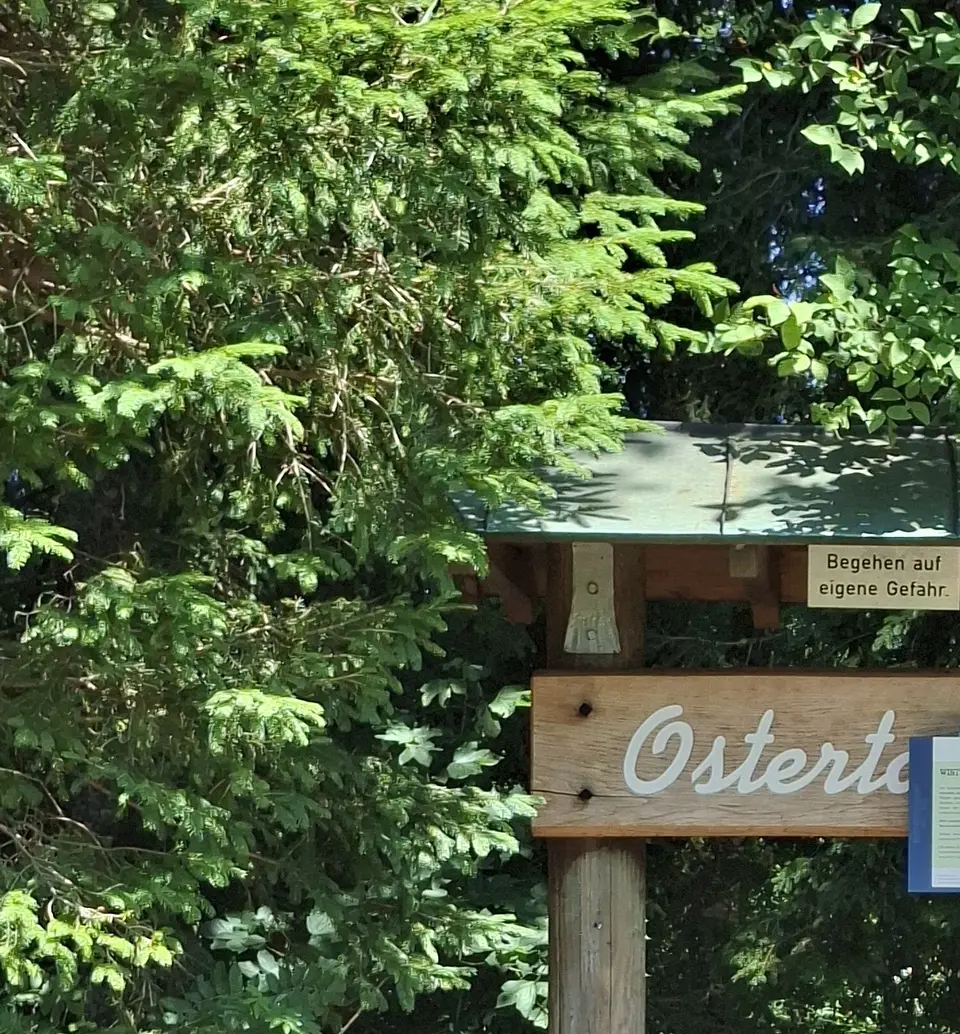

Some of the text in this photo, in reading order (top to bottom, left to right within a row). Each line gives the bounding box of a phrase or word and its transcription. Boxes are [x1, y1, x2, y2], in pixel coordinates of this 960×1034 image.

[827, 553, 942, 574] Begehen auf
[819, 579, 950, 599] eigene Gefahr.
